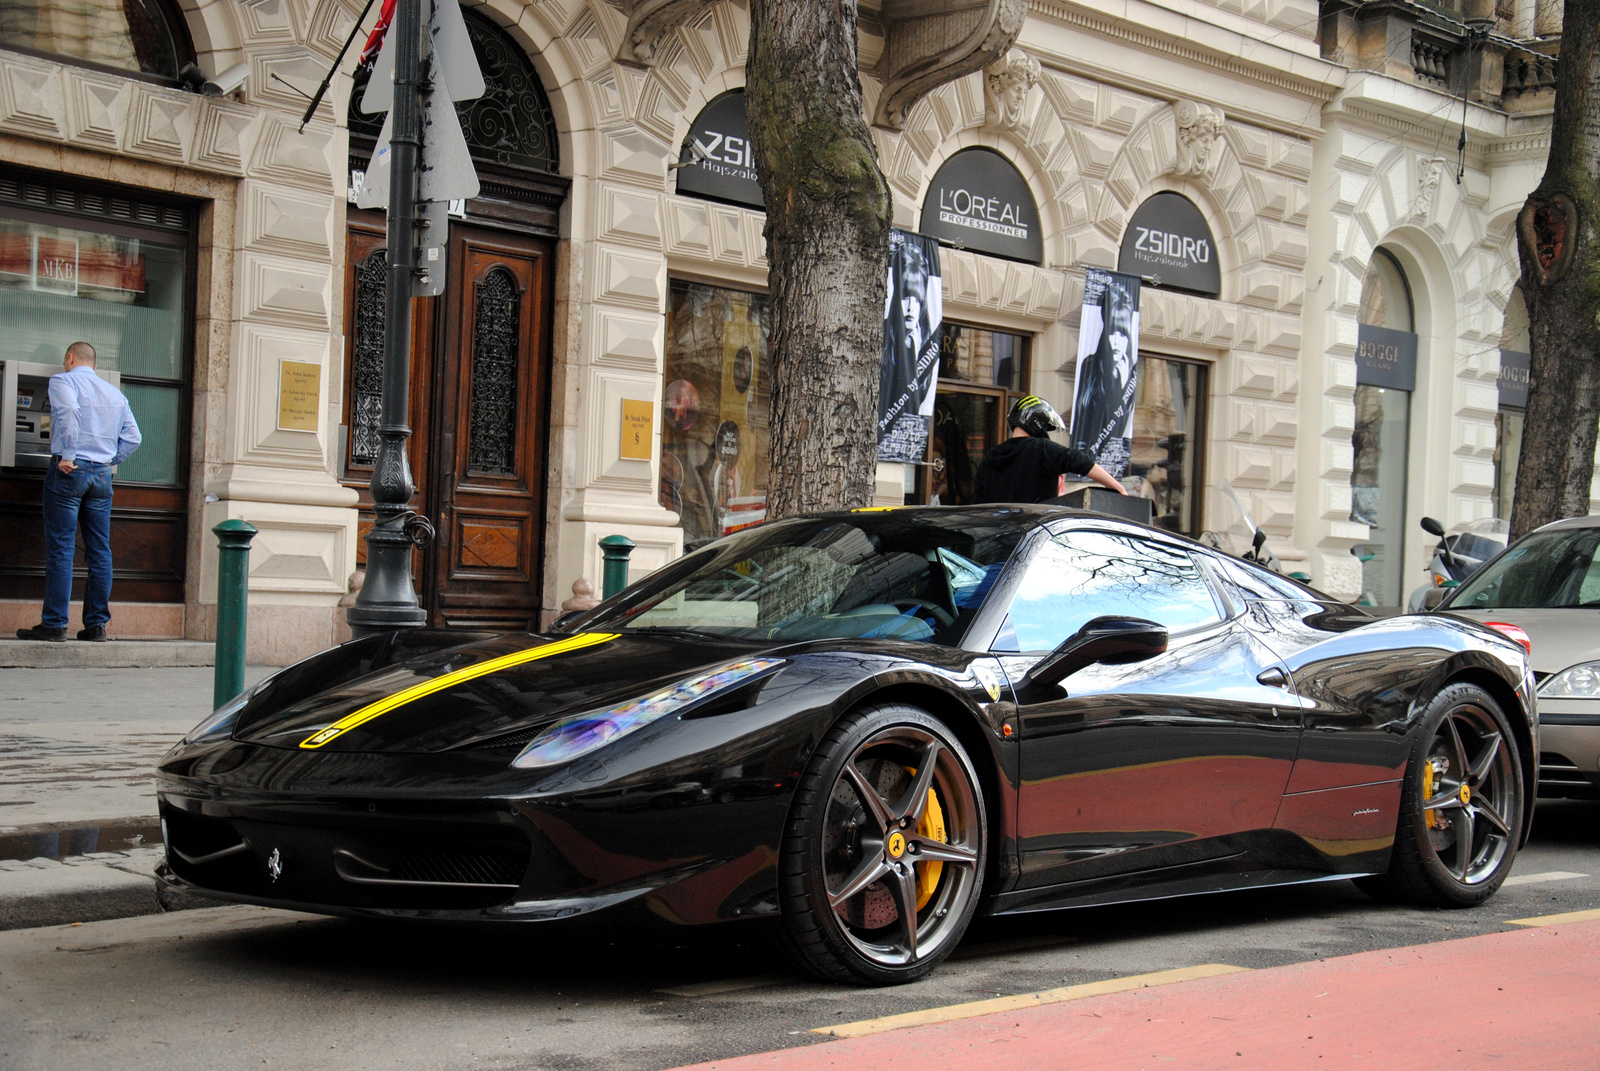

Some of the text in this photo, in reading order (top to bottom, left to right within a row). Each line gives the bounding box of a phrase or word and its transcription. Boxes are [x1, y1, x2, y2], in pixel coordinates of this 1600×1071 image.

[704, 130, 755, 169] ZSI
[940, 187, 1028, 227] L'ORÉAL
[941, 212, 1026, 238] PROFESSIONNEL
[1135, 226, 1209, 264] ZSIDRÓ
[42, 257, 73, 281] MKB
[1359, 341, 1398, 362] BOGGI
[907, 377, 919, 392] by
[1090, 419, 1116, 455] Fashion
[1114, 404, 1124, 418] by
